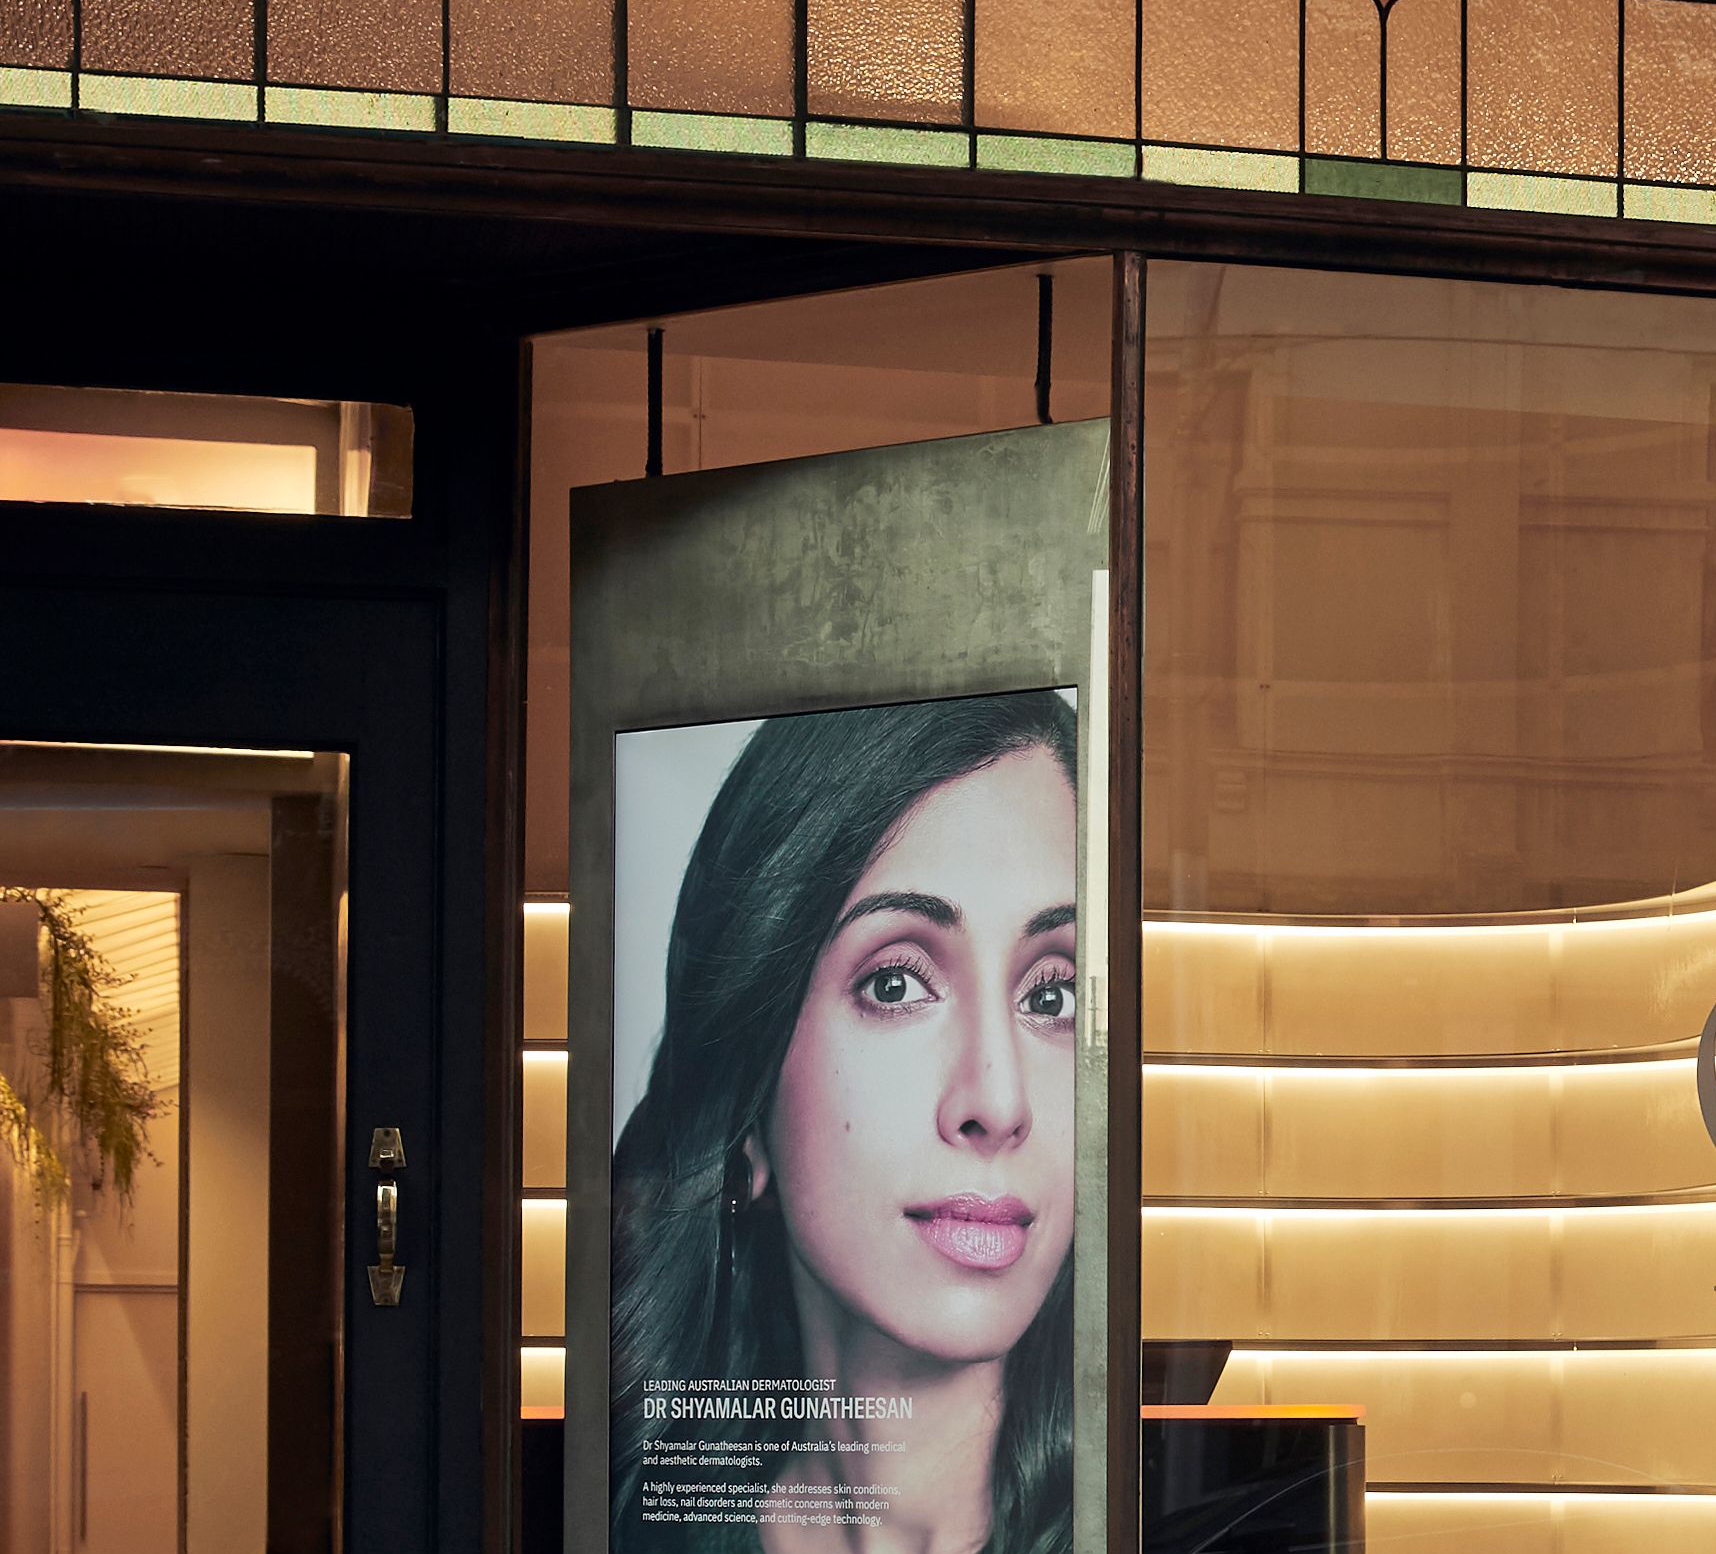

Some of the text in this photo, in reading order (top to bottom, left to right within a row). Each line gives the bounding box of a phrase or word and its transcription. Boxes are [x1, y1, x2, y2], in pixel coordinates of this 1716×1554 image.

[643, 1379, 836, 1391] LEADING AUSTRALIAN DERMATOLOGIST
[643, 1397, 913, 1419] DR SHYAMALAR GUNATHEESAN
[643, 1440, 652, 1451] Dr
[654, 1440, 697, 1452] Shyamalar
[698, 1440, 753, 1451] Gunatheesan
[755, 1440, 762, 1451] is
[763, 1443, 779, 1451] one
[781, 1441, 790, 1451] of
[837, 1441, 869, 1454] leading
[871, 1441, 907, 1452] medical
[643, 1455, 763, 1468] and aesthetic dermatologists.
[643, 1482, 901, 1496] A highly experienced specialist, she addresses skin conditions,
[643, 1496, 889, 1510] hair loss, nail disorders and cosmetic concerns with modern
[643, 1511, 882, 1527] medicine, advanced science, and cutting-edge technology.
